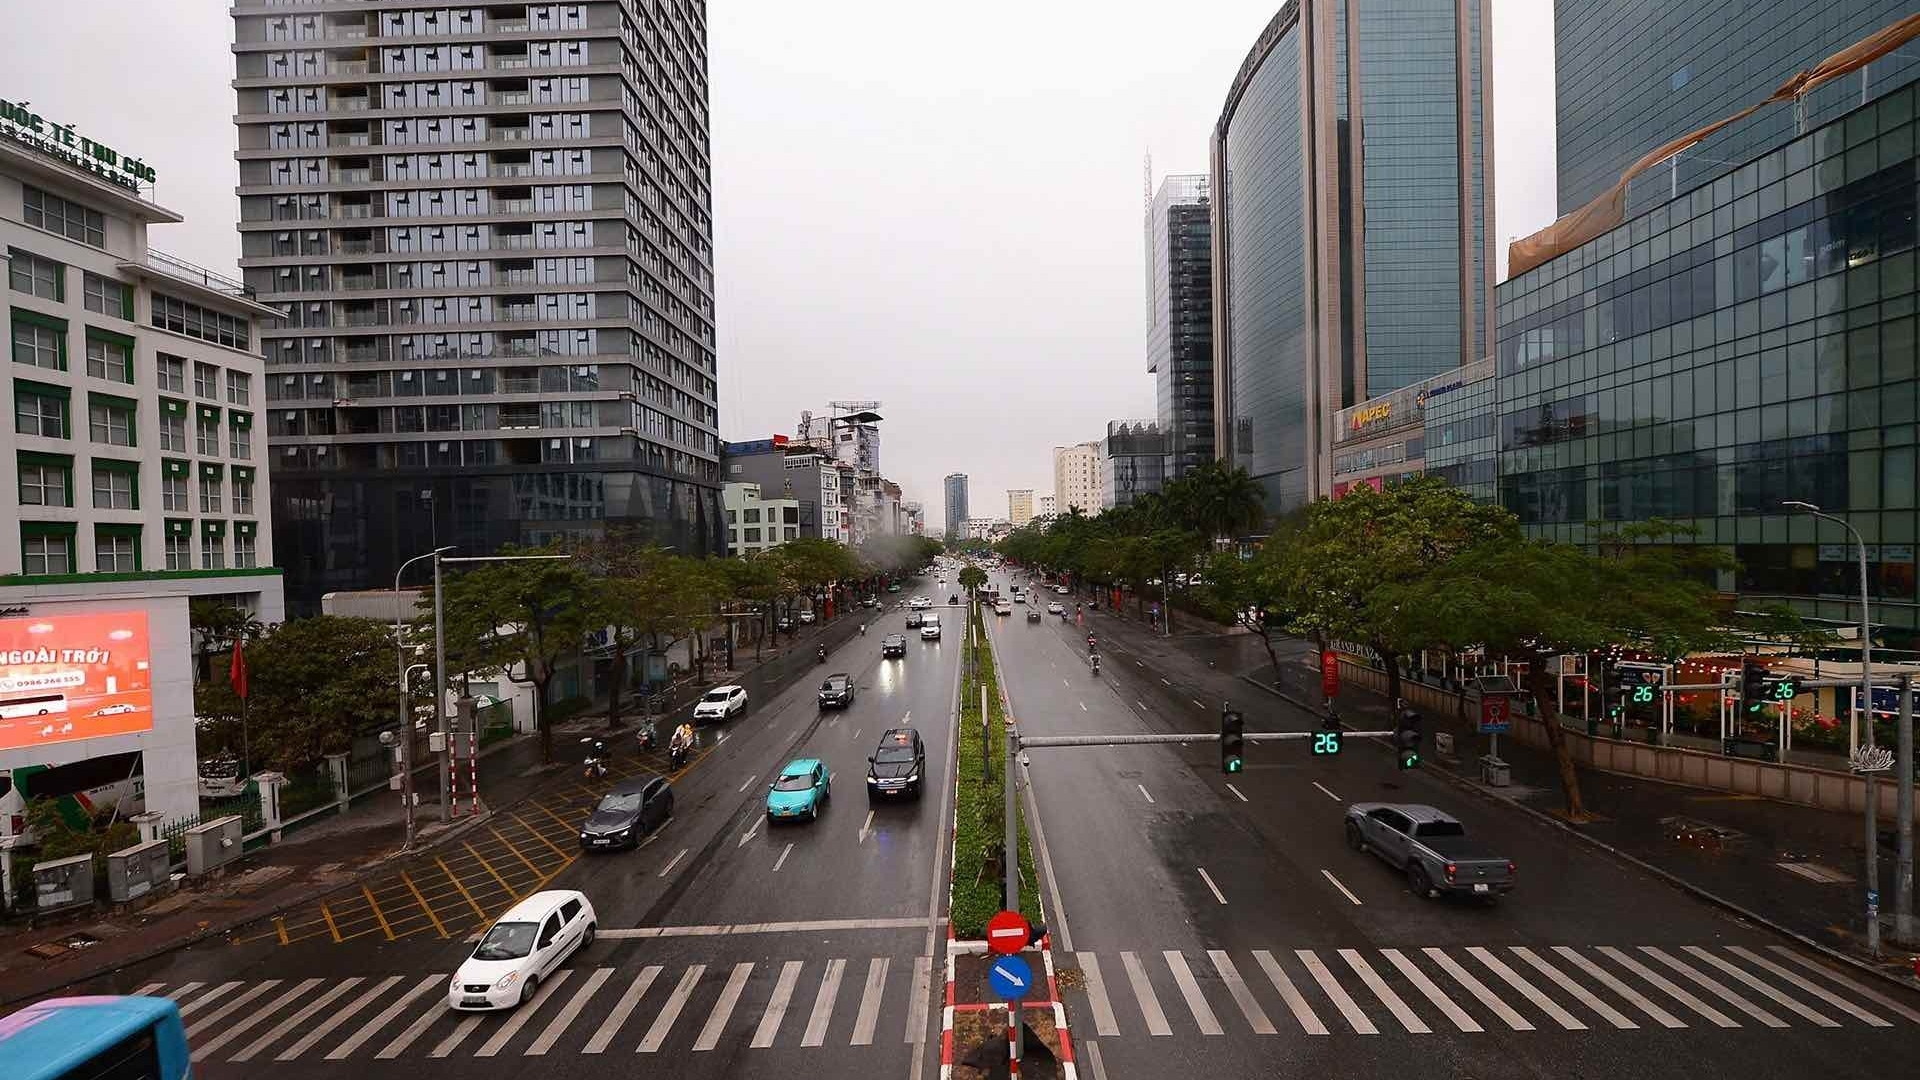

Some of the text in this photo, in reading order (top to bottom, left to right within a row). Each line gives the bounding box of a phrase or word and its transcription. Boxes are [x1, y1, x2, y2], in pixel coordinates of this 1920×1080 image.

[51, 122, 76, 148] TẾ
[81, 137, 116, 165] THU
[123, 157, 156, 183] CÚC
[1360, 404, 1390, 424] APEC
[1633, 686, 1652, 702] 26
[1774, 683, 1794, 699] 26
[1314, 733, 1338, 753] 26
